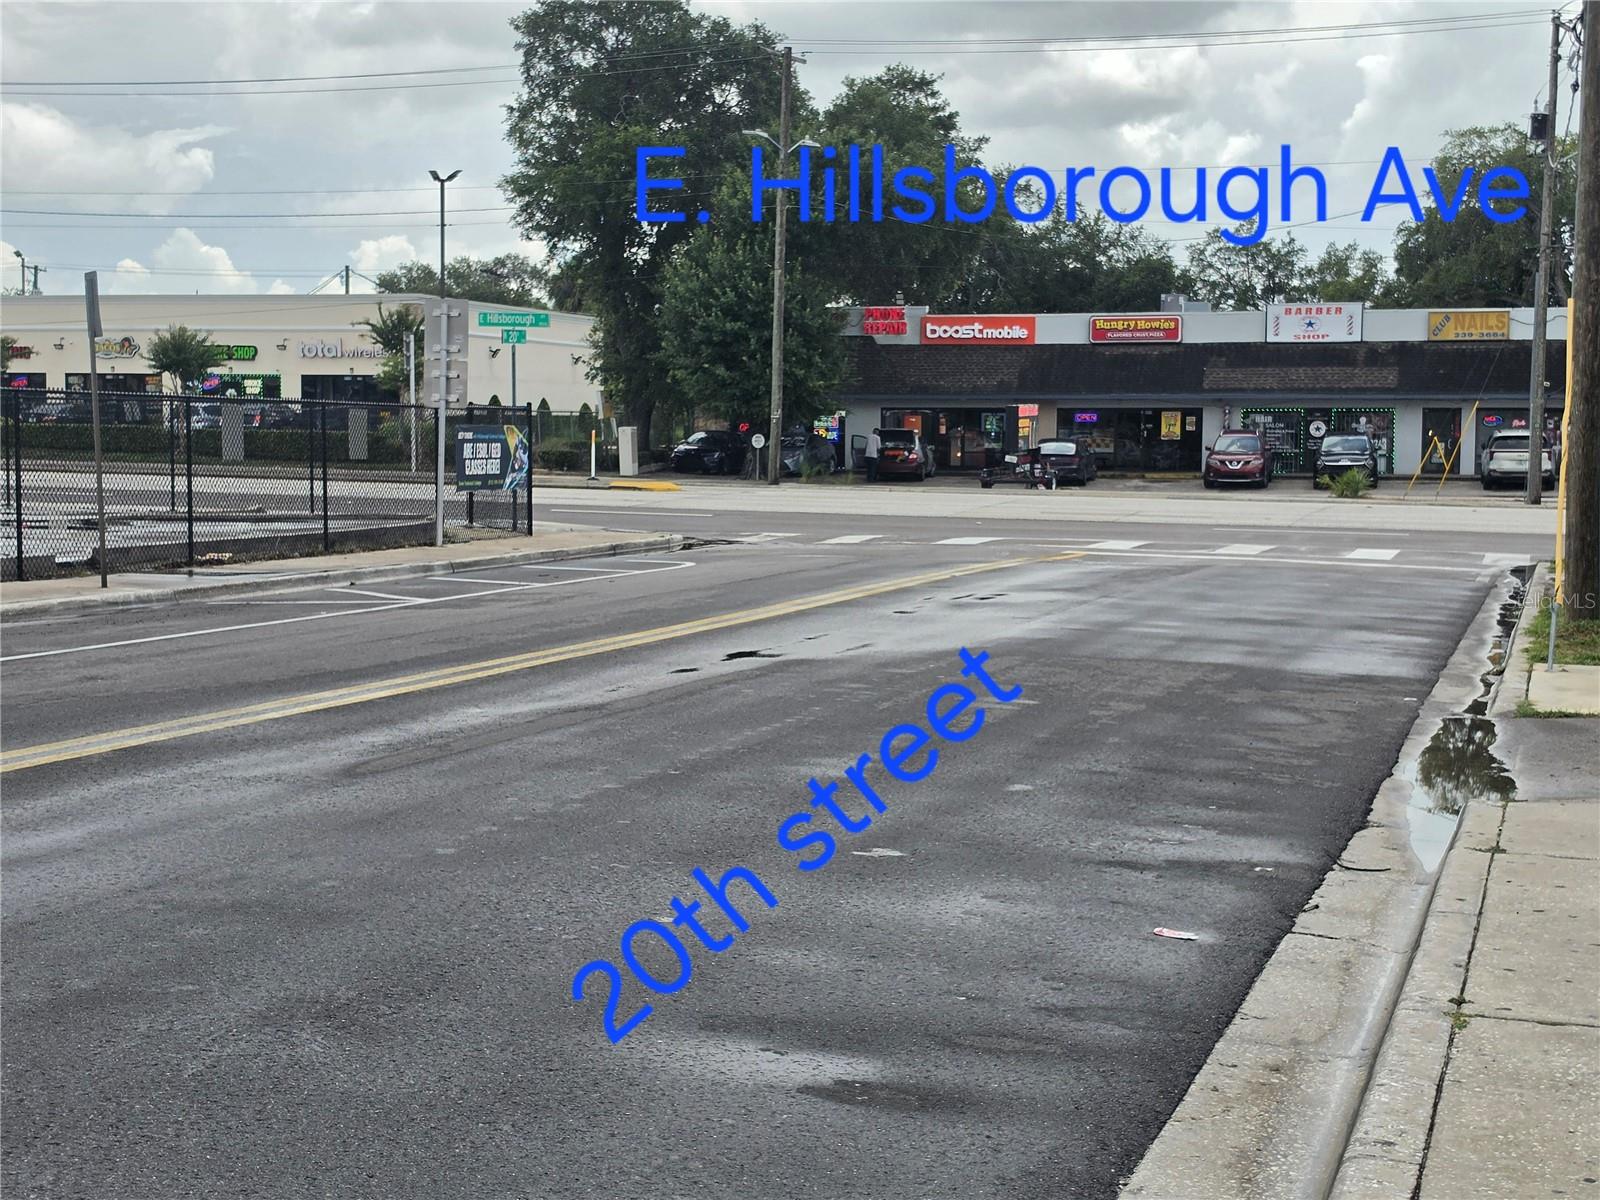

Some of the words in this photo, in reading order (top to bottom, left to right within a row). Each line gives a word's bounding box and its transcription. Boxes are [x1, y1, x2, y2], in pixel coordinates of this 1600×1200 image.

[864, 308, 905, 320] PHONE
[1284, 307, 1342, 316] BARBER
[487, 313, 535, 327] Hillsborough
[1096, 320, 1136, 330] Hungry
[1137, 319, 1175, 330] Howie's
[1432, 314, 1451, 336] CLUB
[1453, 313, 1506, 331] NAILS
[864, 322, 908, 335] REPAIR
[232, 346, 256, 359] SHOP
[300, 340, 343, 358] total
[344, 345, 393, 358] wireles
